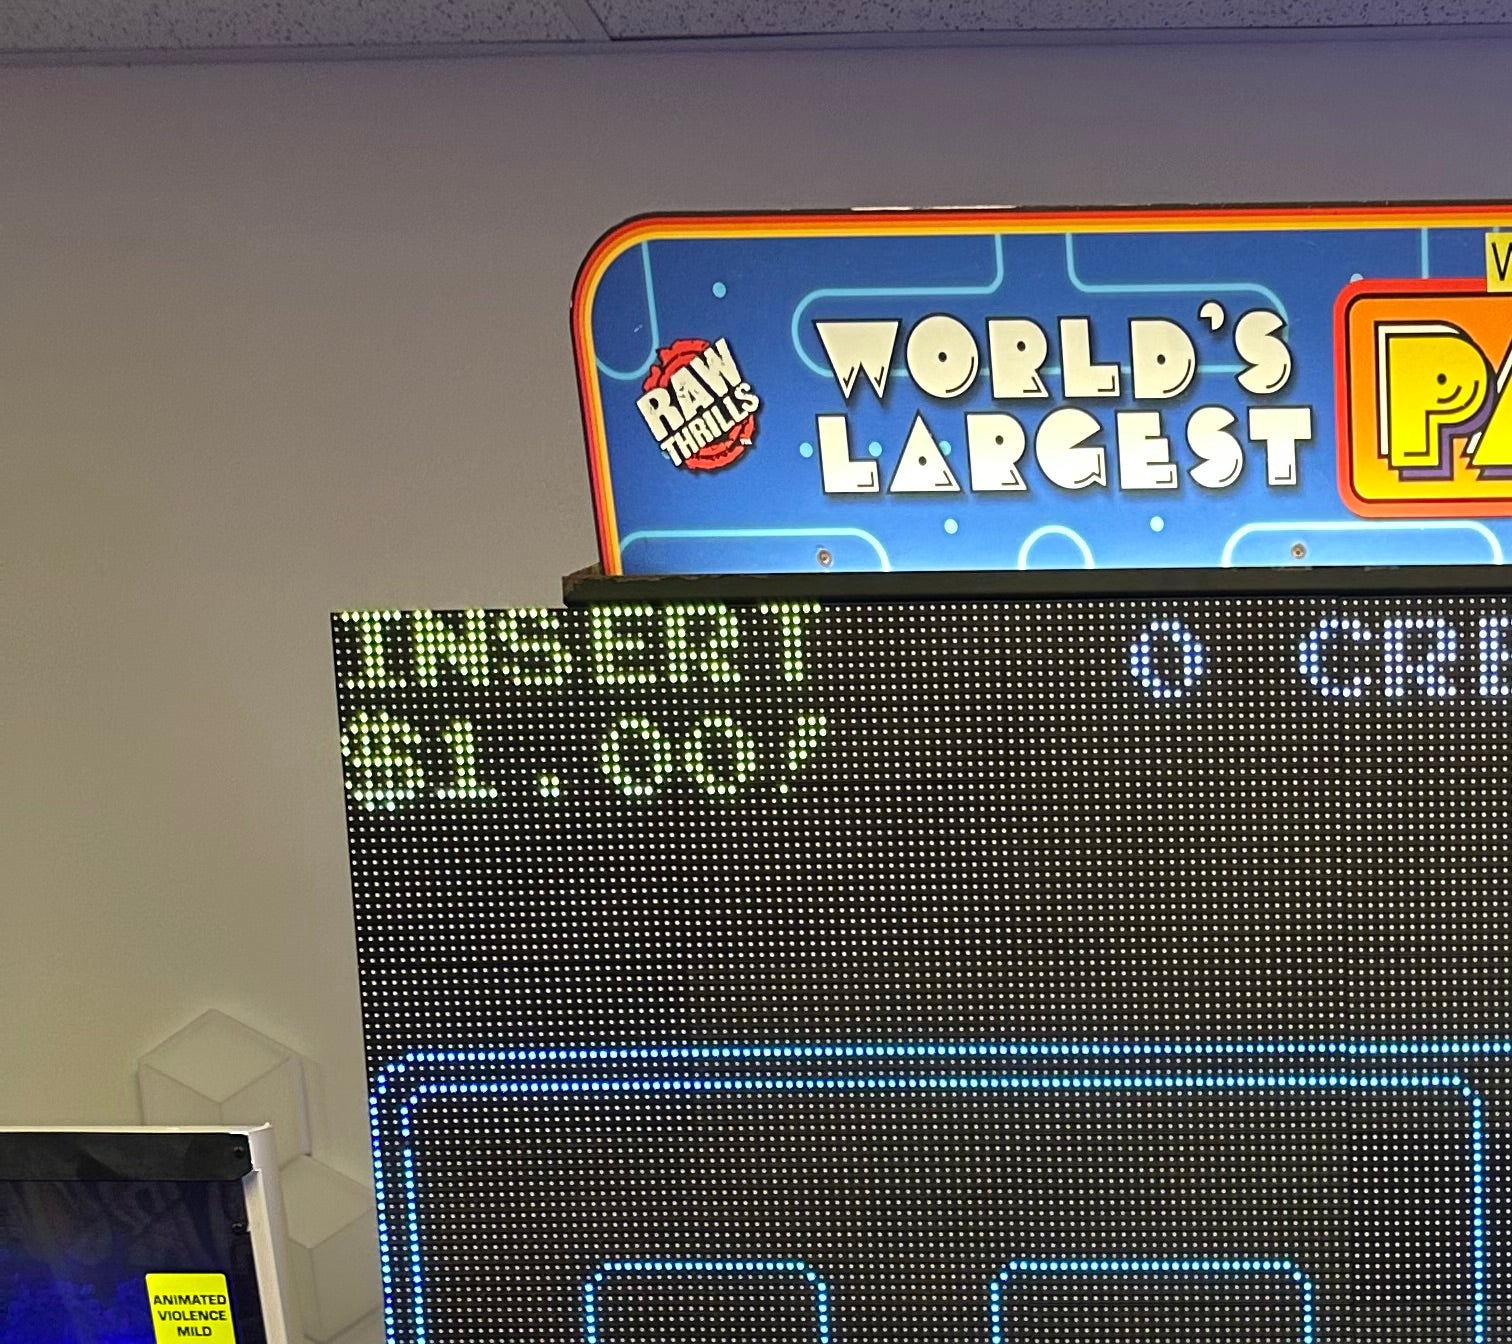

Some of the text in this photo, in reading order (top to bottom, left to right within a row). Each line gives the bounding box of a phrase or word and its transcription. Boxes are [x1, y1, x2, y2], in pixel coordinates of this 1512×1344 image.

[636, 337, 742, 442] RAW
[813, 301, 1292, 400] WORLD'S
[660, 382, 760, 467] THRILLS
[815, 406, 1312, 495] LARGEST
[341, 606, 822, 689] INSERT
[153, 1294, 227, 1305] ANIMATED
[158, 1310, 227, 1321] VIOLENCE
[177, 1326, 213, 1337] MILD
